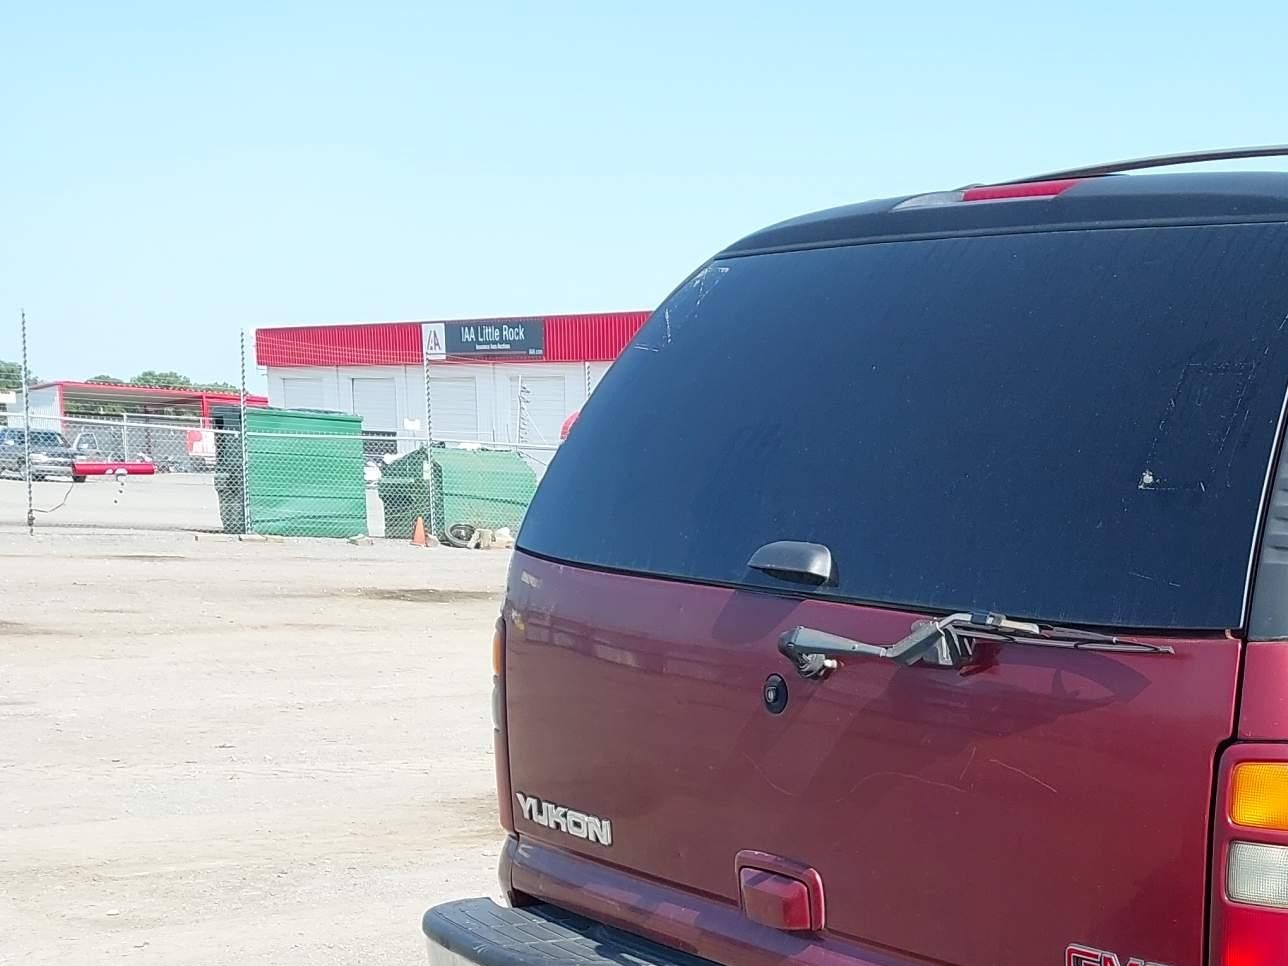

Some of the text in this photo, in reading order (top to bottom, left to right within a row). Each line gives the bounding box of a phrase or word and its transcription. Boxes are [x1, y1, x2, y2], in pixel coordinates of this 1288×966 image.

[461, 324, 525, 342] IAA Little Rock
[515, 791, 613, 846] YUKON
